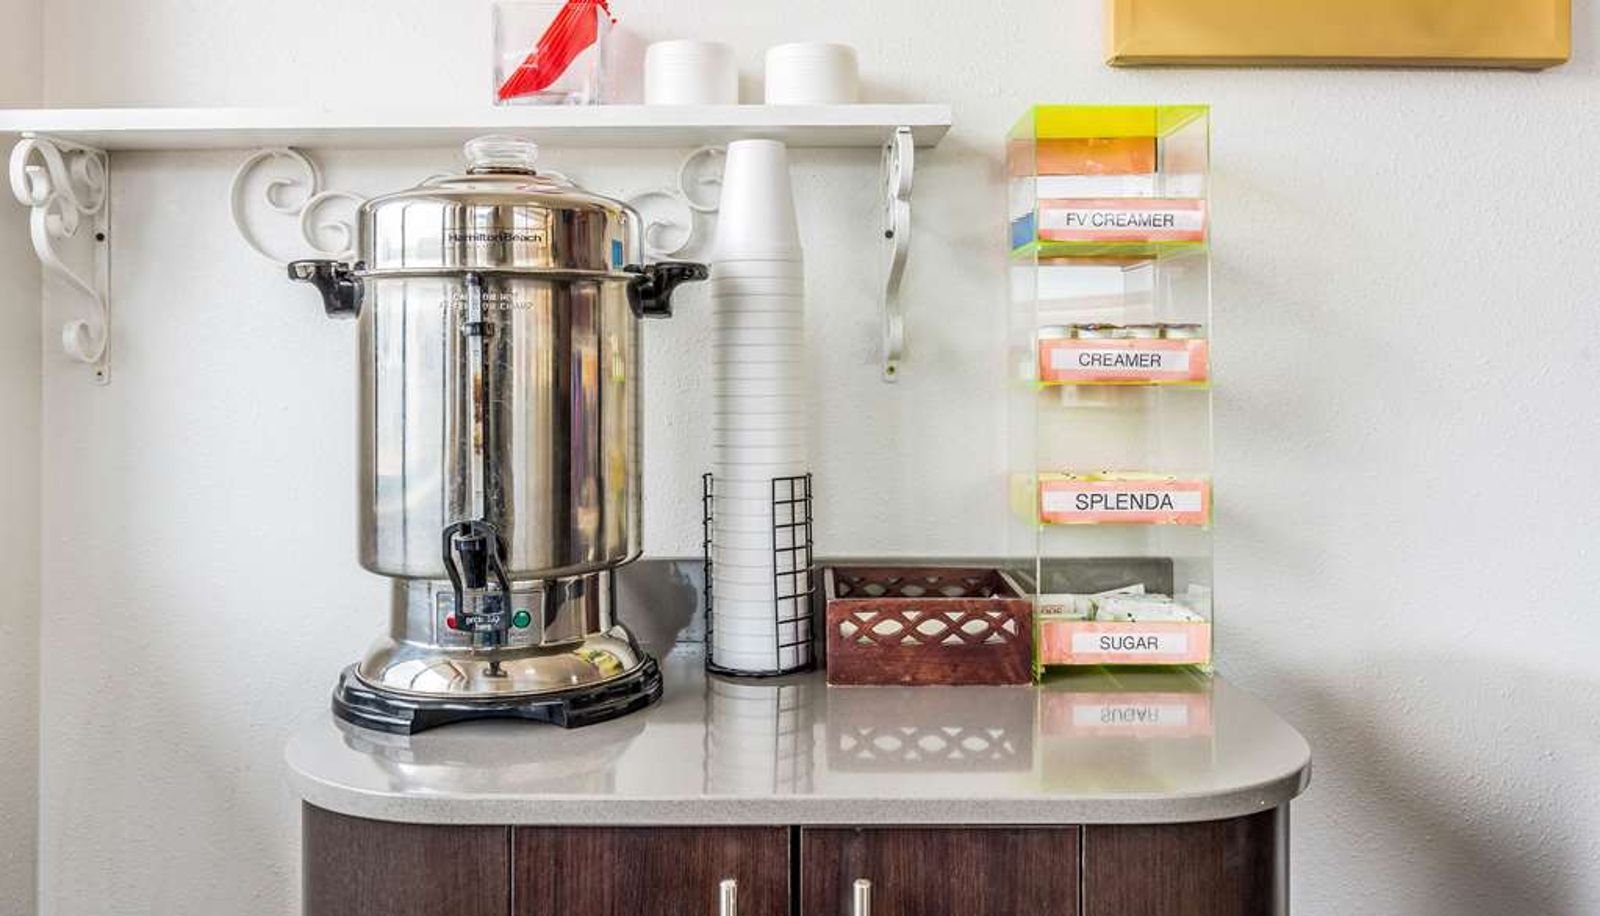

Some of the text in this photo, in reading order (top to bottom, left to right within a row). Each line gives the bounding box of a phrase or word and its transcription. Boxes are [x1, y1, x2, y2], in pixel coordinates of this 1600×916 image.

[1066, 212, 1175, 228] FV CREAMER
[1078, 353, 1162, 367] CREAMER
[1075, 493, 1174, 511] SPLENDA
[1100, 635, 1159, 650] SUGAR
